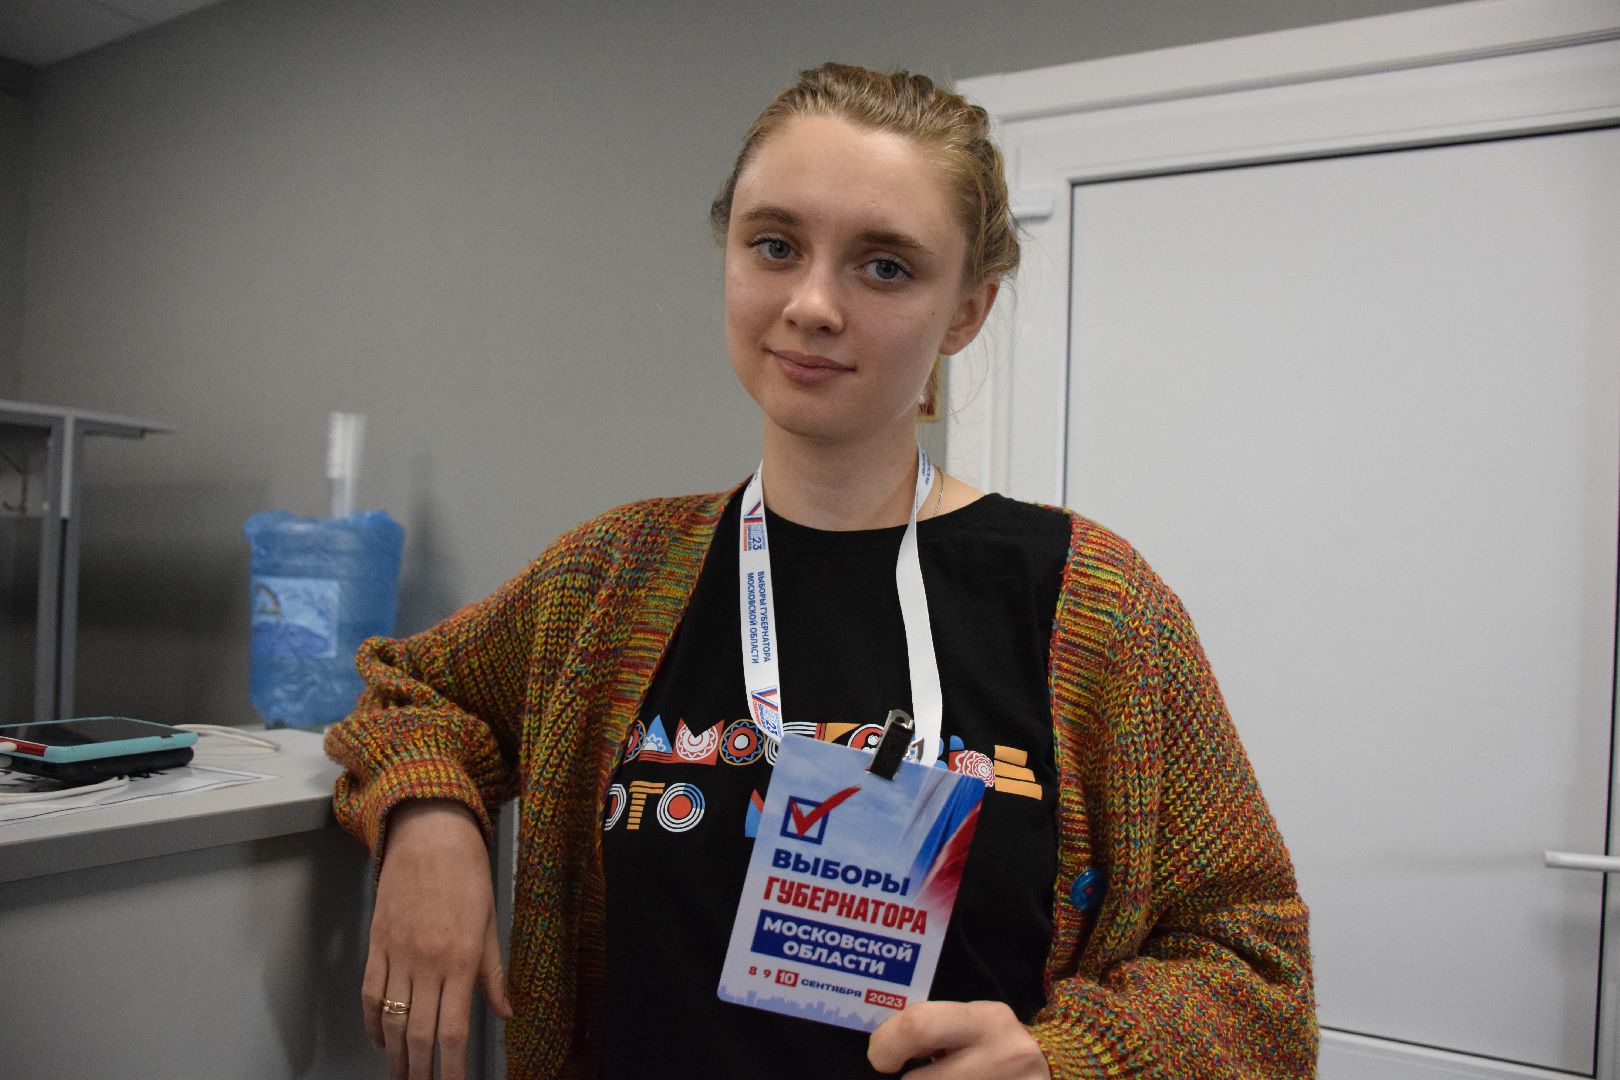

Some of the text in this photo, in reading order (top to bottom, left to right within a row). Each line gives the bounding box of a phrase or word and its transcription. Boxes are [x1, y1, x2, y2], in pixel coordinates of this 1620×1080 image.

[747, 572, 759, 664] МОСКОВСКОЙ ОБЛАСТИ
[757, 570, 771, 663] ВЫБОРЫ ГУБЕРНАТОРА
[772, 848, 911, 897] ВЫБОРЫ
[763, 875, 927, 935] ГУБЕРНАТОРА
[763, 917, 914, 962] МОСКОВСКОЙ
[783, 940, 886, 976] ОБЛАСТИ
[748, 966, 904, 1008] 8 9 10 СЕНТЯБРЯ 2023
